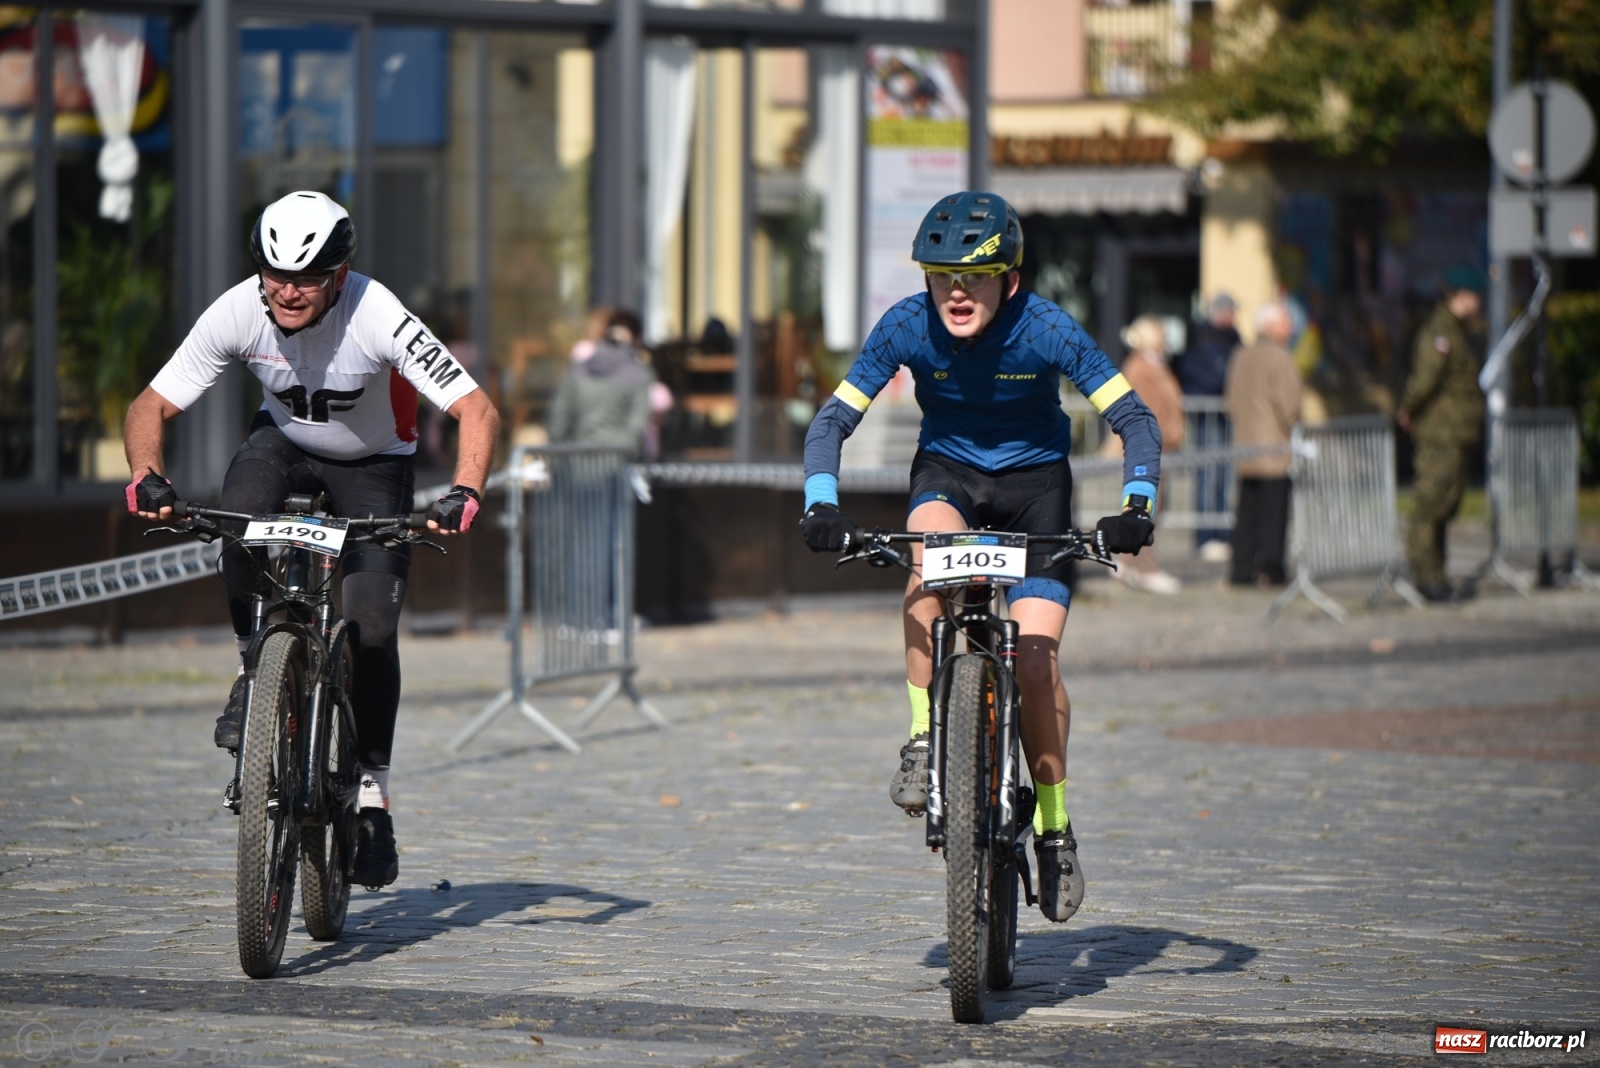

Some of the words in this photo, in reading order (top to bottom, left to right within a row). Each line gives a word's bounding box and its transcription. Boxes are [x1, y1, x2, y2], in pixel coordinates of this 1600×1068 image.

[960, 232, 1002, 263] MET
[392, 311, 464, 390] TEAM
[263, 525, 328, 542] 1490
[942, 551, 1007, 571] 1405
